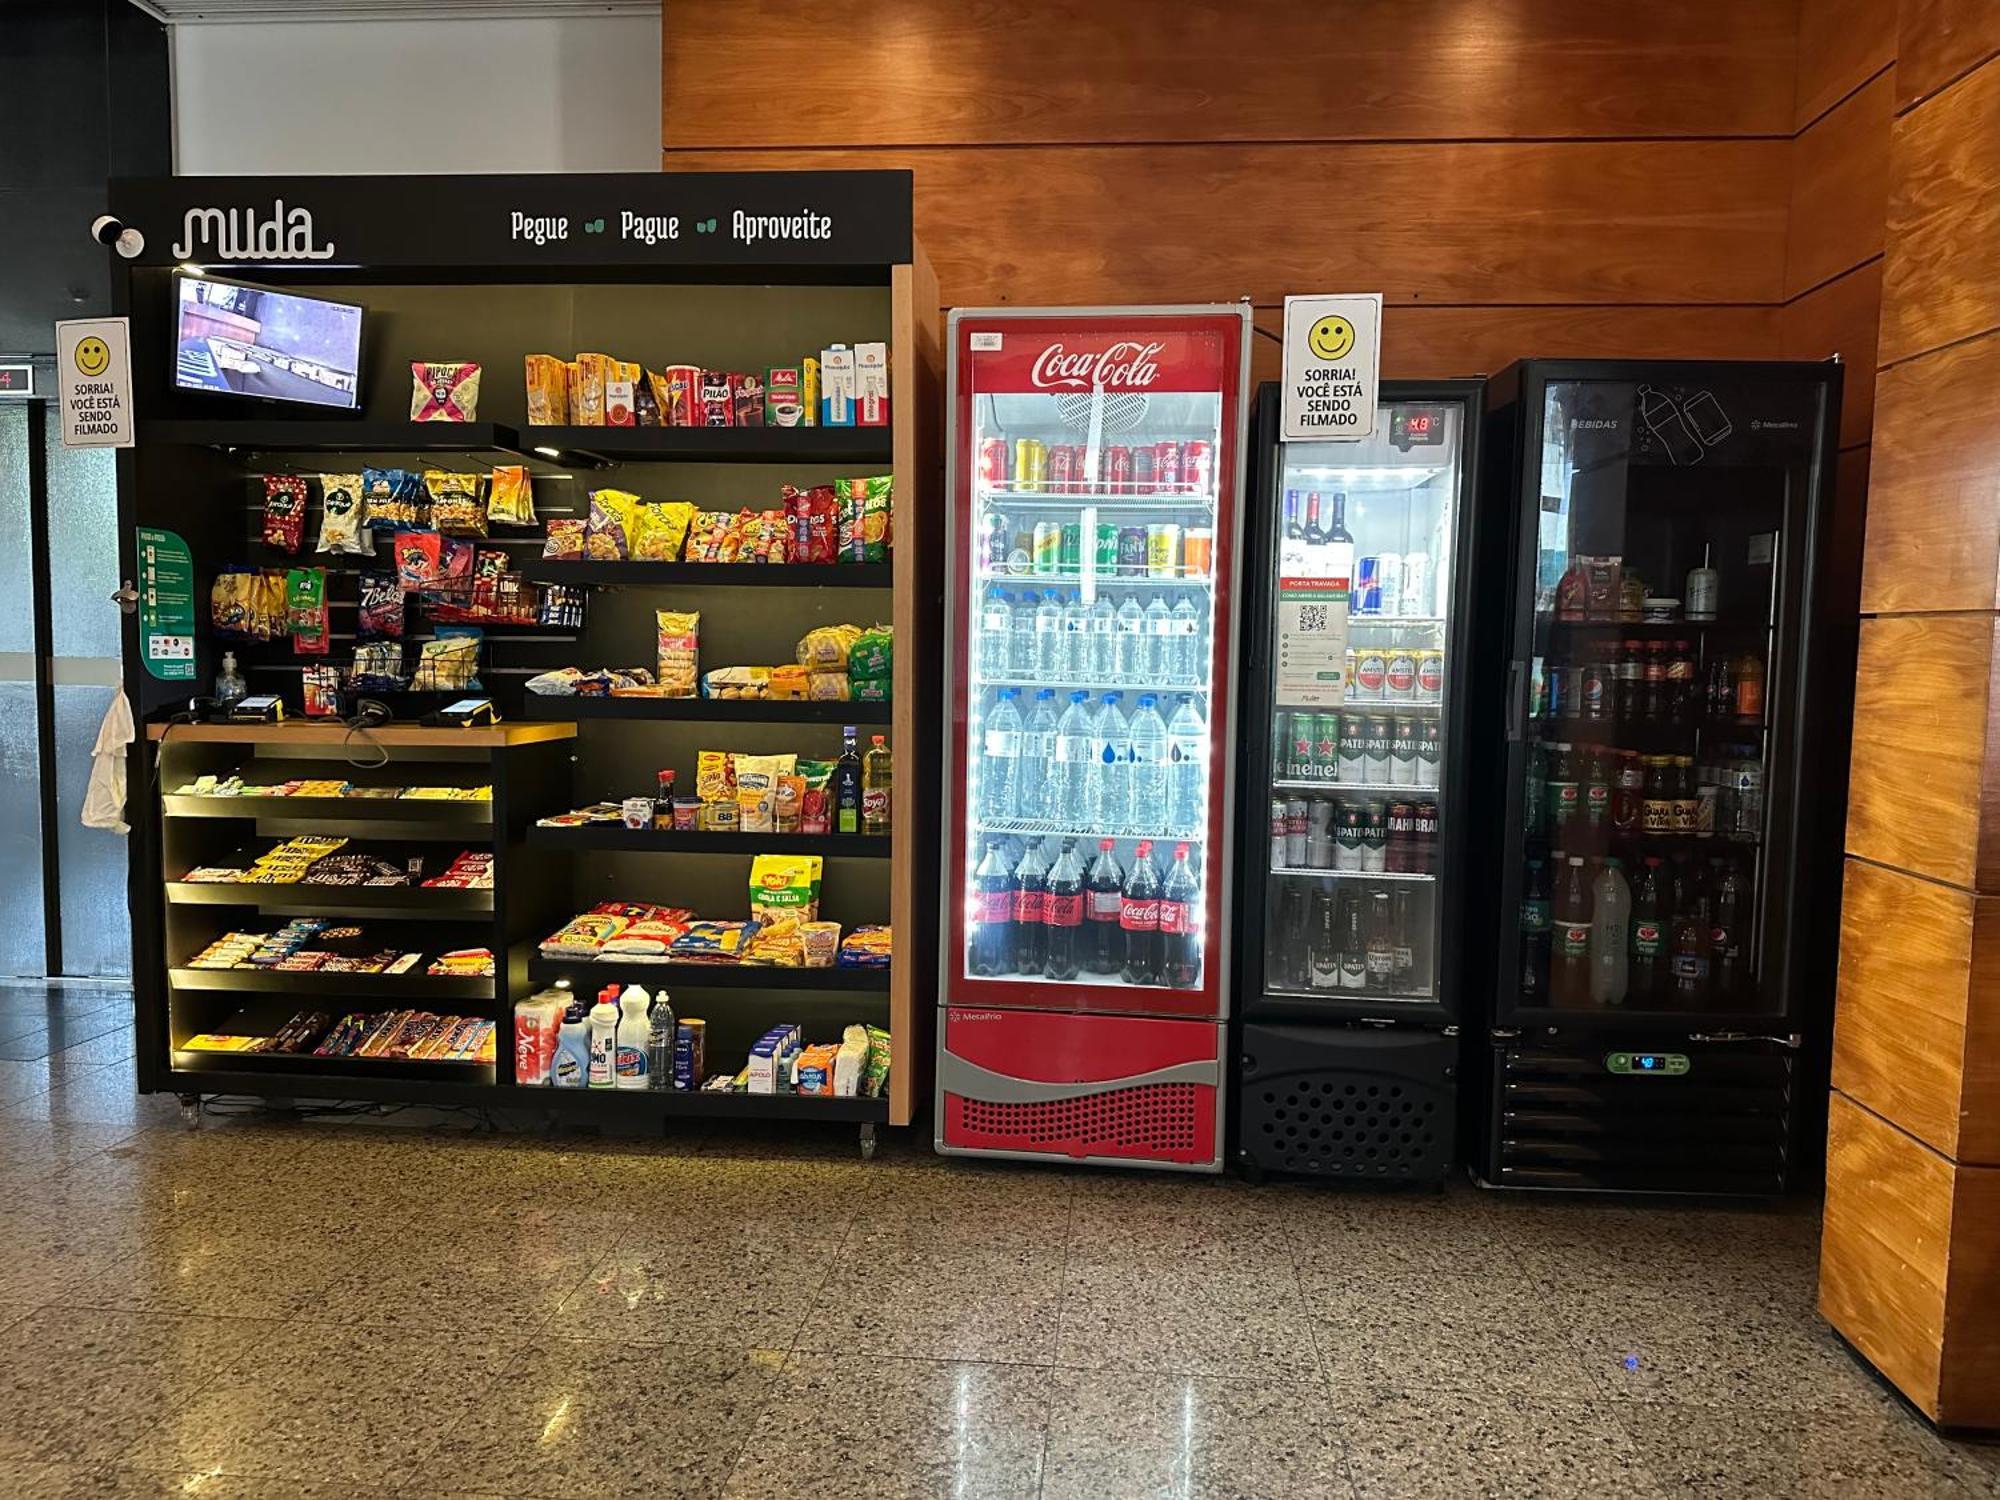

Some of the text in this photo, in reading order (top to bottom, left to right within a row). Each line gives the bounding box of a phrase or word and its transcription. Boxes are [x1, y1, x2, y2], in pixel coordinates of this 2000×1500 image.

[173, 200, 334, 259] muda
[511, 208, 832, 245] Pegue Pague Aproveite
[1031, 342, 1165, 388] Coca-Cola
[1304, 368, 1356, 381] SORRIA!
[75, 384, 113, 395] SORRIA!
[1297, 381, 1363, 398] VOCÊ ESTÁ
[70, 394, 120, 409] VOCÊ ESTÁ
[1307, 400, 1351, 412] SENDO
[79, 410, 112, 422] SENDO
[1300, 413, 1358, 426] FILMADO
[74, 423, 118, 435] FILMADO
[1570, 418, 1617, 430] BEBIDAS
[518, 1027, 535, 1070] Neve
